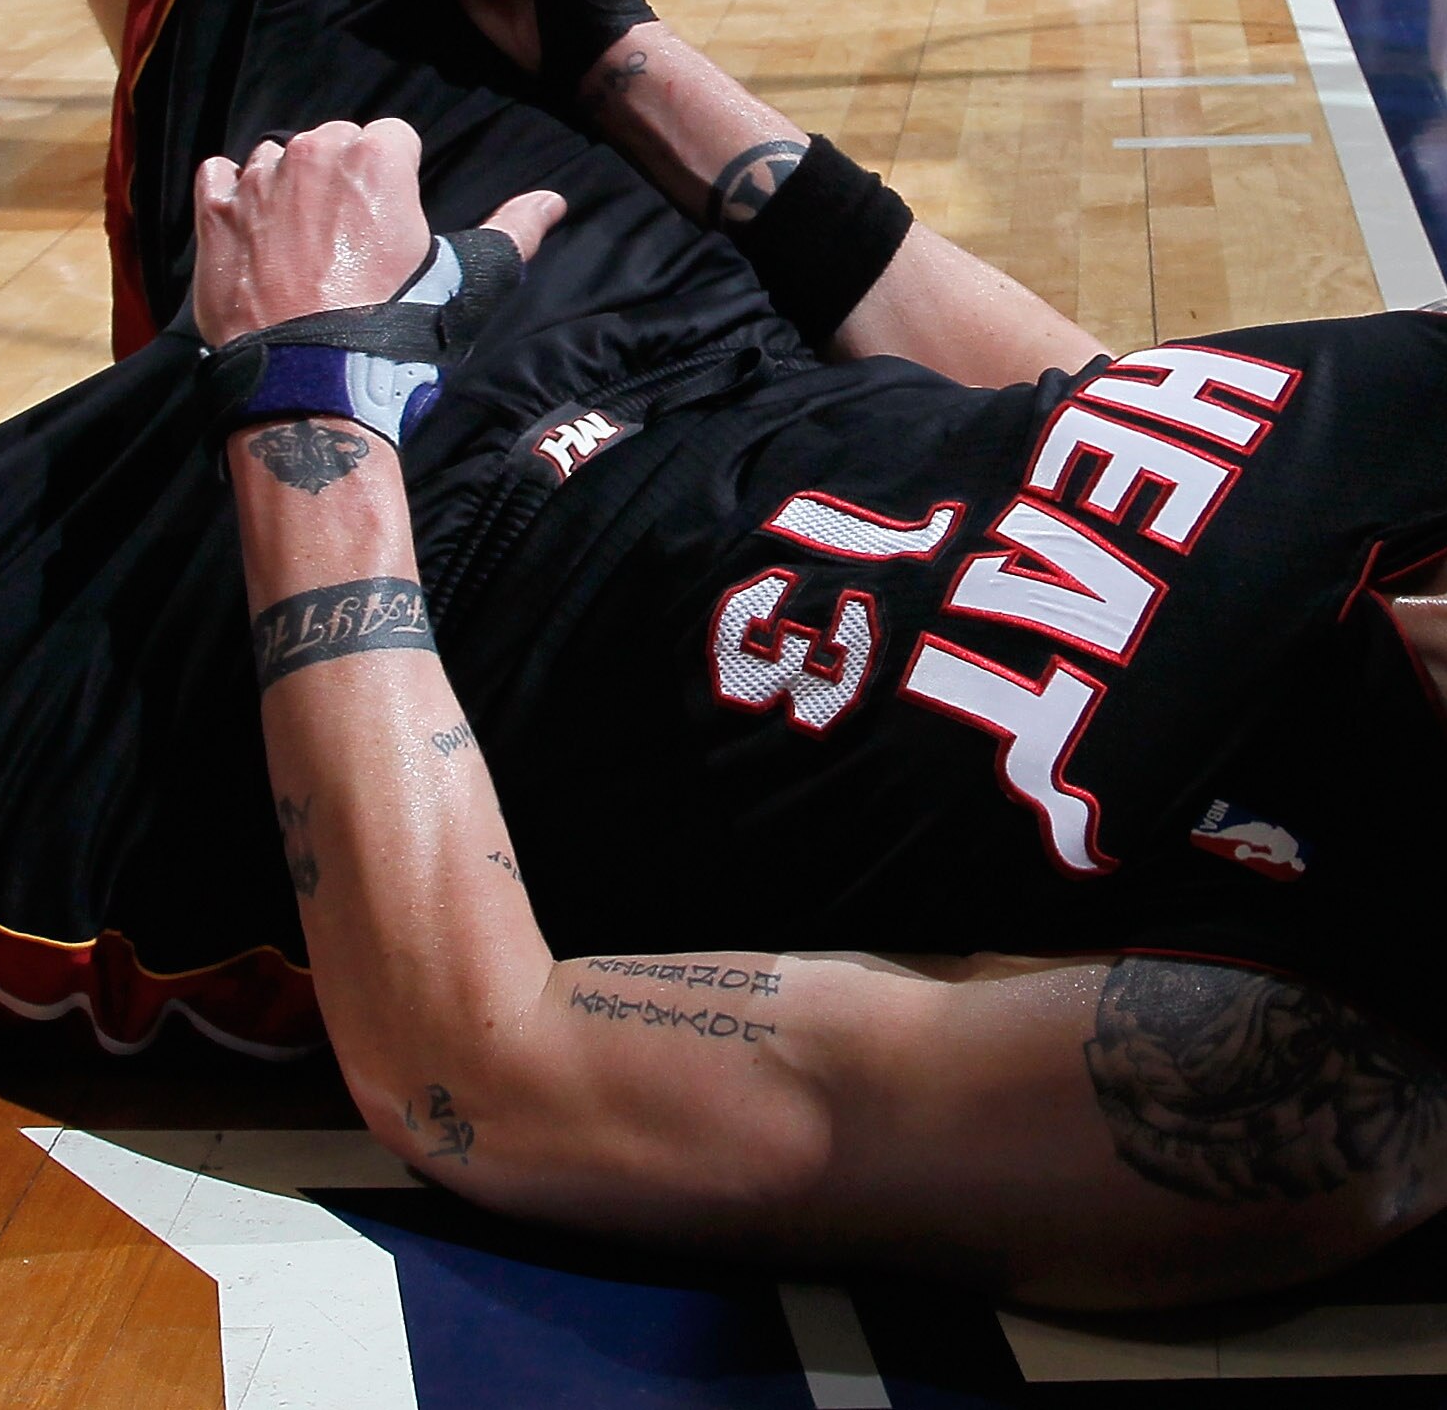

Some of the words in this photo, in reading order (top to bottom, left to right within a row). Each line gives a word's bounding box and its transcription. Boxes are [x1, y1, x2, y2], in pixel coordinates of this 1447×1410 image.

[706, 491, 966, 740] 13
[896, 345, 1302, 880] HEAT
[1199, 798, 1230, 830] NBA
